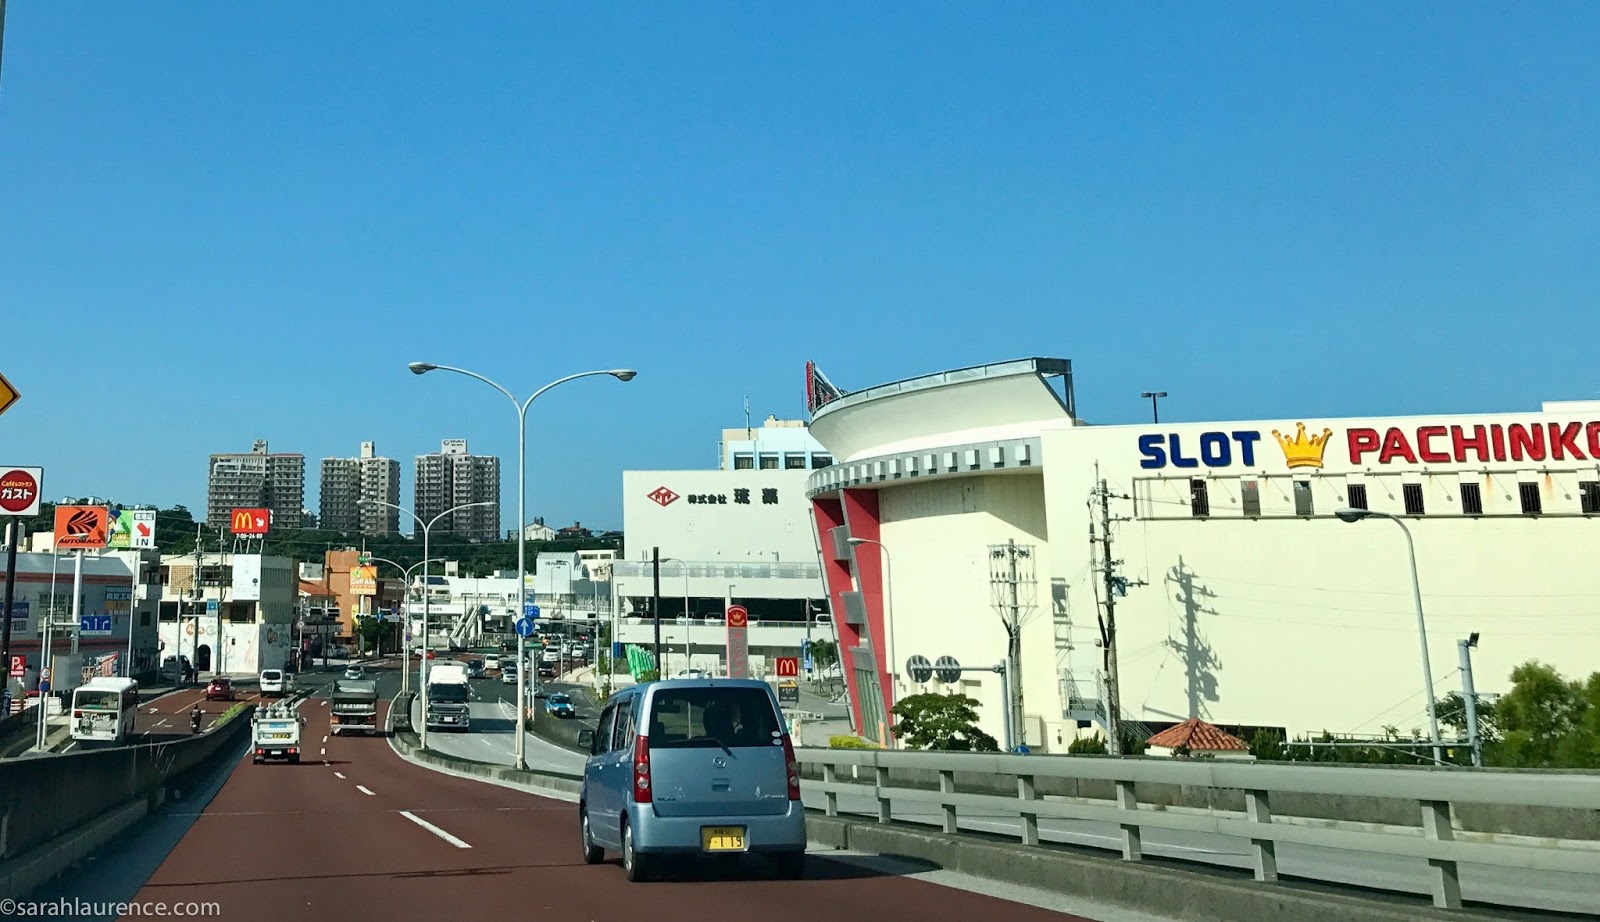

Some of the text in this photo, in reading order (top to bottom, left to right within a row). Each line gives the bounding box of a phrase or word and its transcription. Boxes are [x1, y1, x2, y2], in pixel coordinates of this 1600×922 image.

[1138, 430, 1261, 469] SLOT
[1, 488, 33, 499] ガスト
[135, 538, 149, 546] IN
